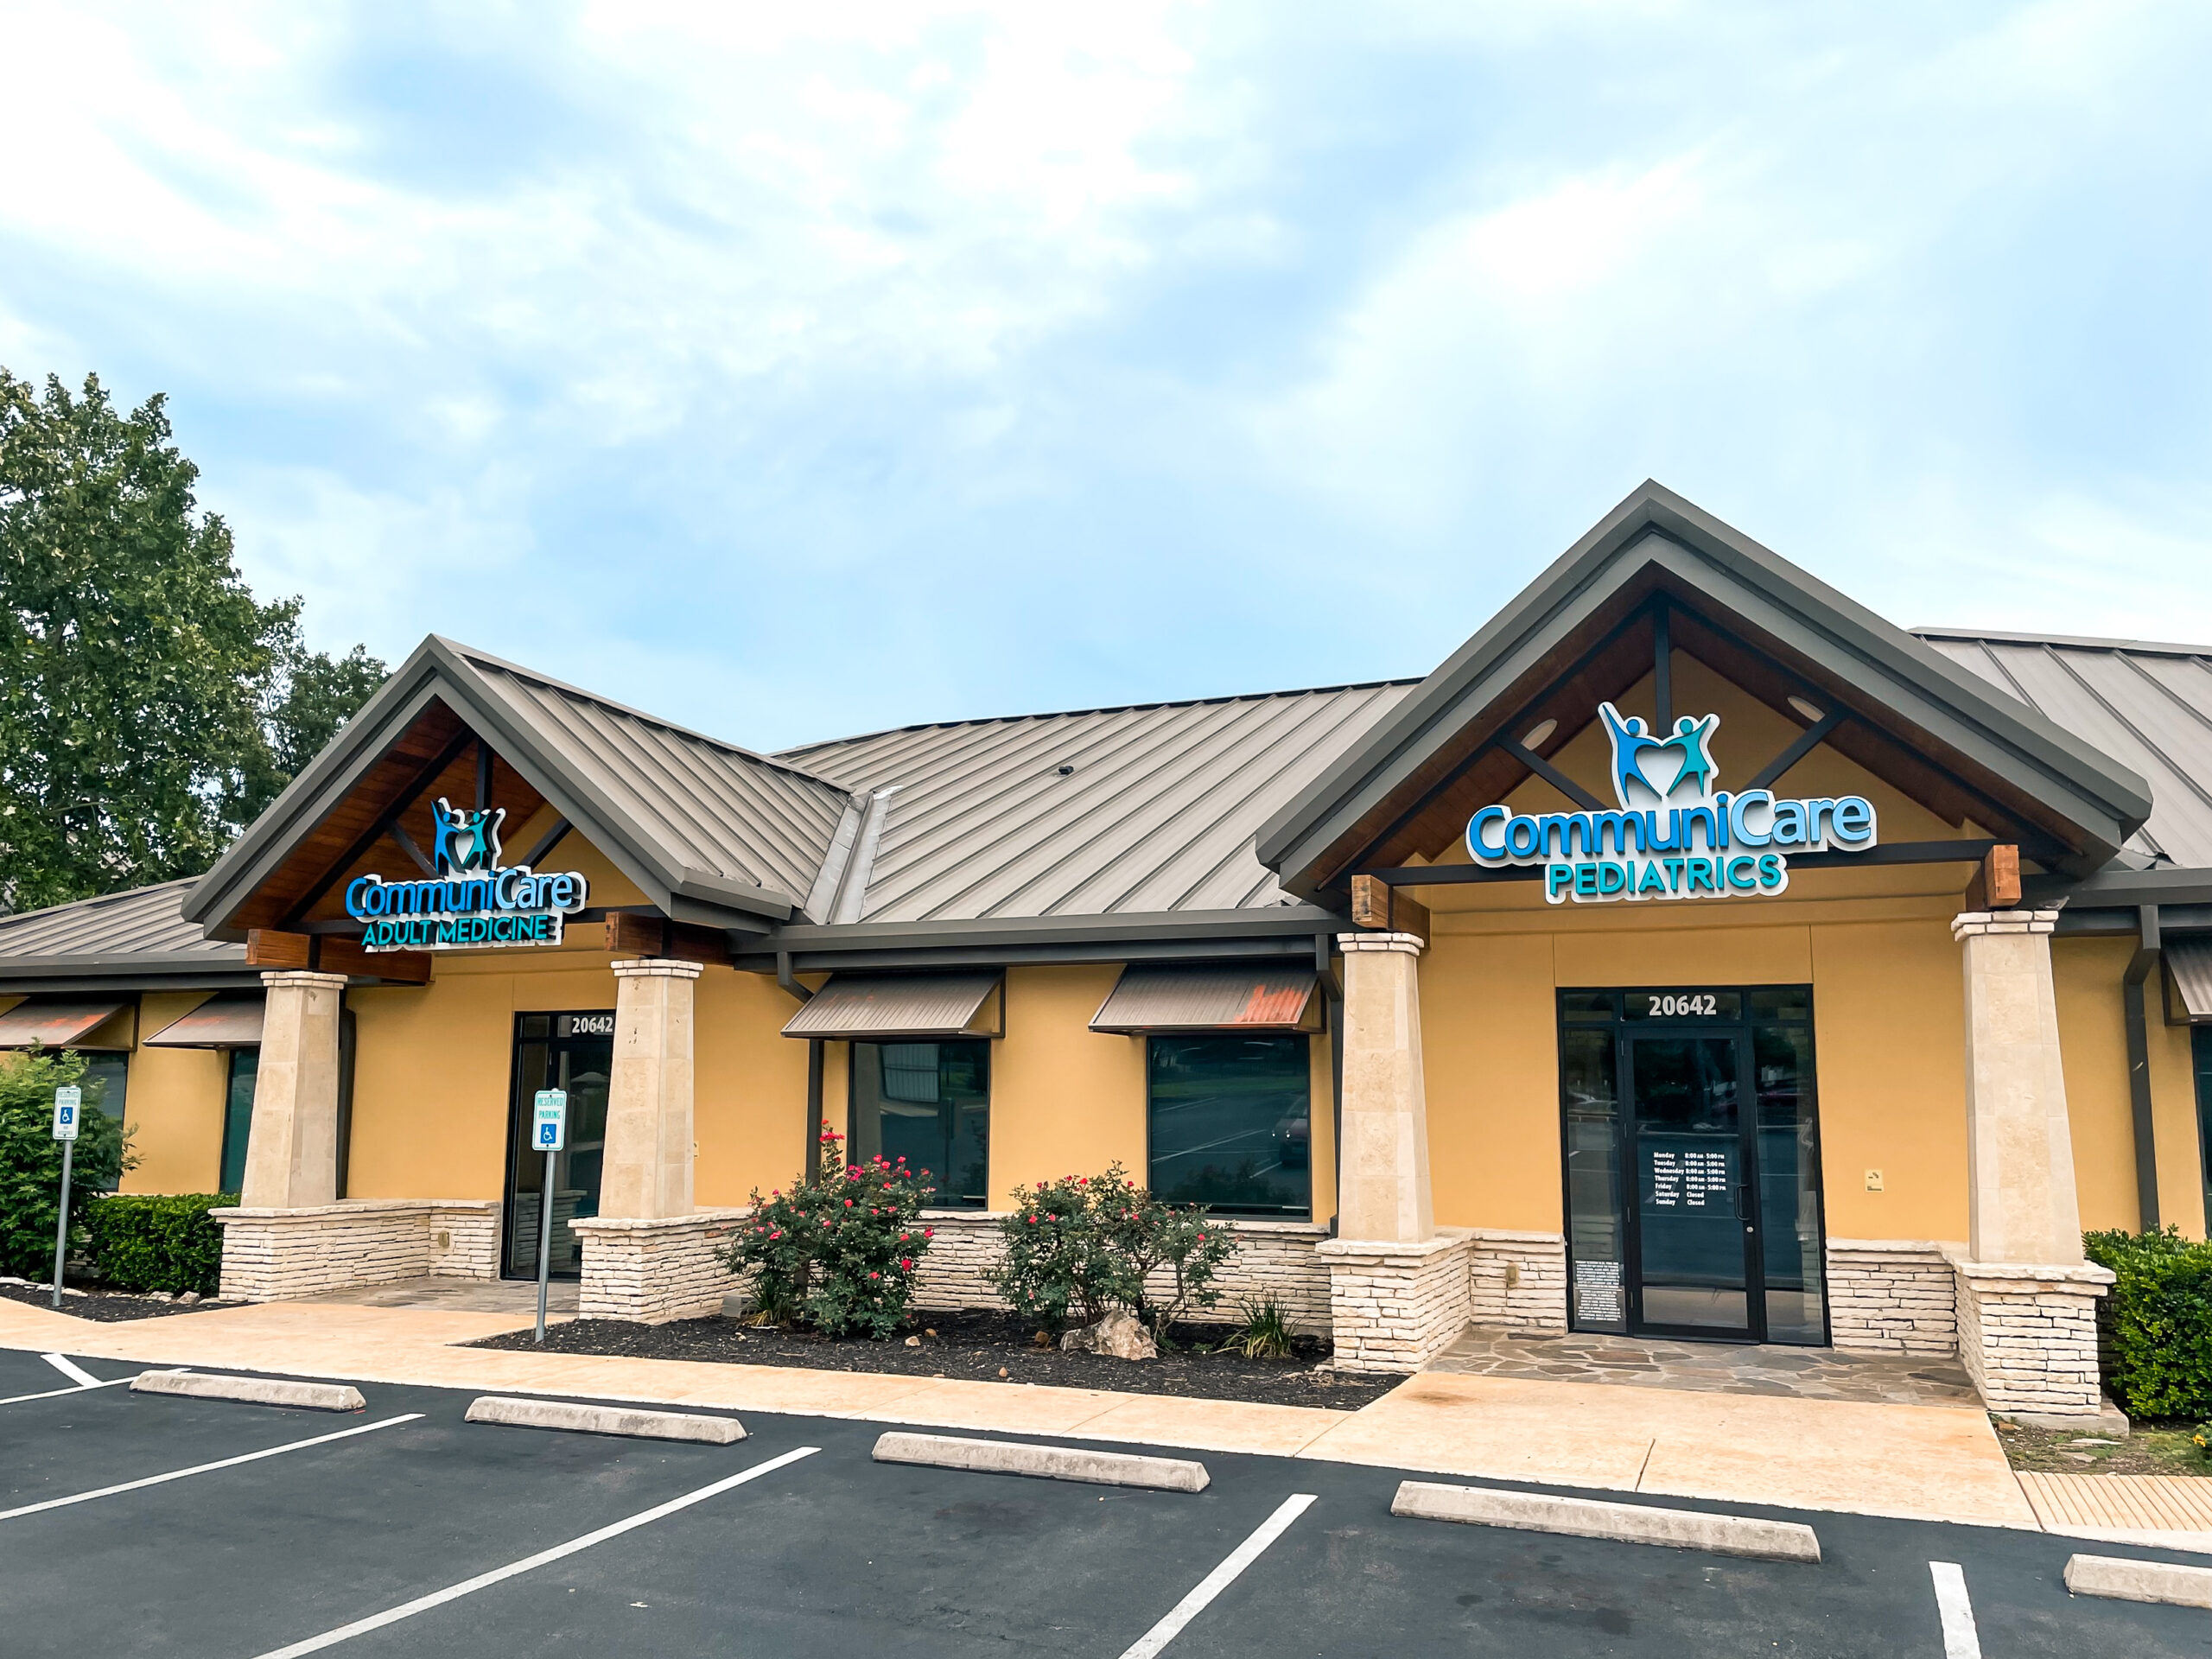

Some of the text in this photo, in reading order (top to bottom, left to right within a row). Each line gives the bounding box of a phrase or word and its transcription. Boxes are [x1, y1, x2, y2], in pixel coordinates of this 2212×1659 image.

[1468, 792, 1872, 858] CommuniCare
[1549, 854, 1783, 895] PEDIATRICS
[346, 869, 573, 917] CommuniCare
[361, 914, 550, 947] ADULT MEDICINE
[1649, 995, 1717, 1016] 20642
[571, 1016, 613, 1033] 20642
[537, 1097, 563, 1106] RESERVED
[538, 1110, 561, 1119] PARKING
